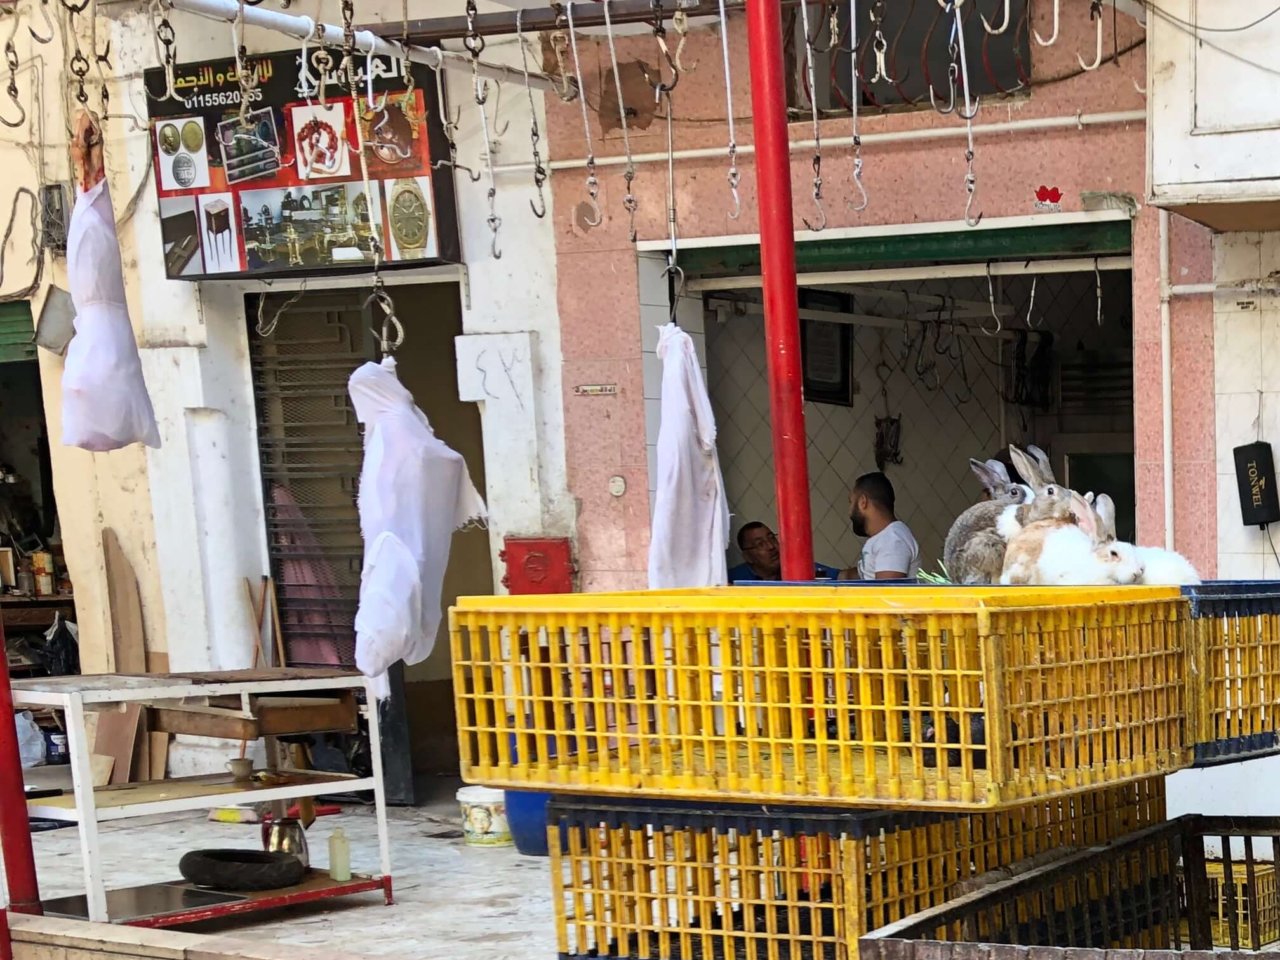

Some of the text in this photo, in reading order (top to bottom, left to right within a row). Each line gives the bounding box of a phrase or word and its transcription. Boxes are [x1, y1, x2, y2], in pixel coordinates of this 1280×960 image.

[294, 54, 406, 97] العبسي
[185, 88, 262, 109] 0115562055
[1247, 460, 1262, 508] TONWEL
